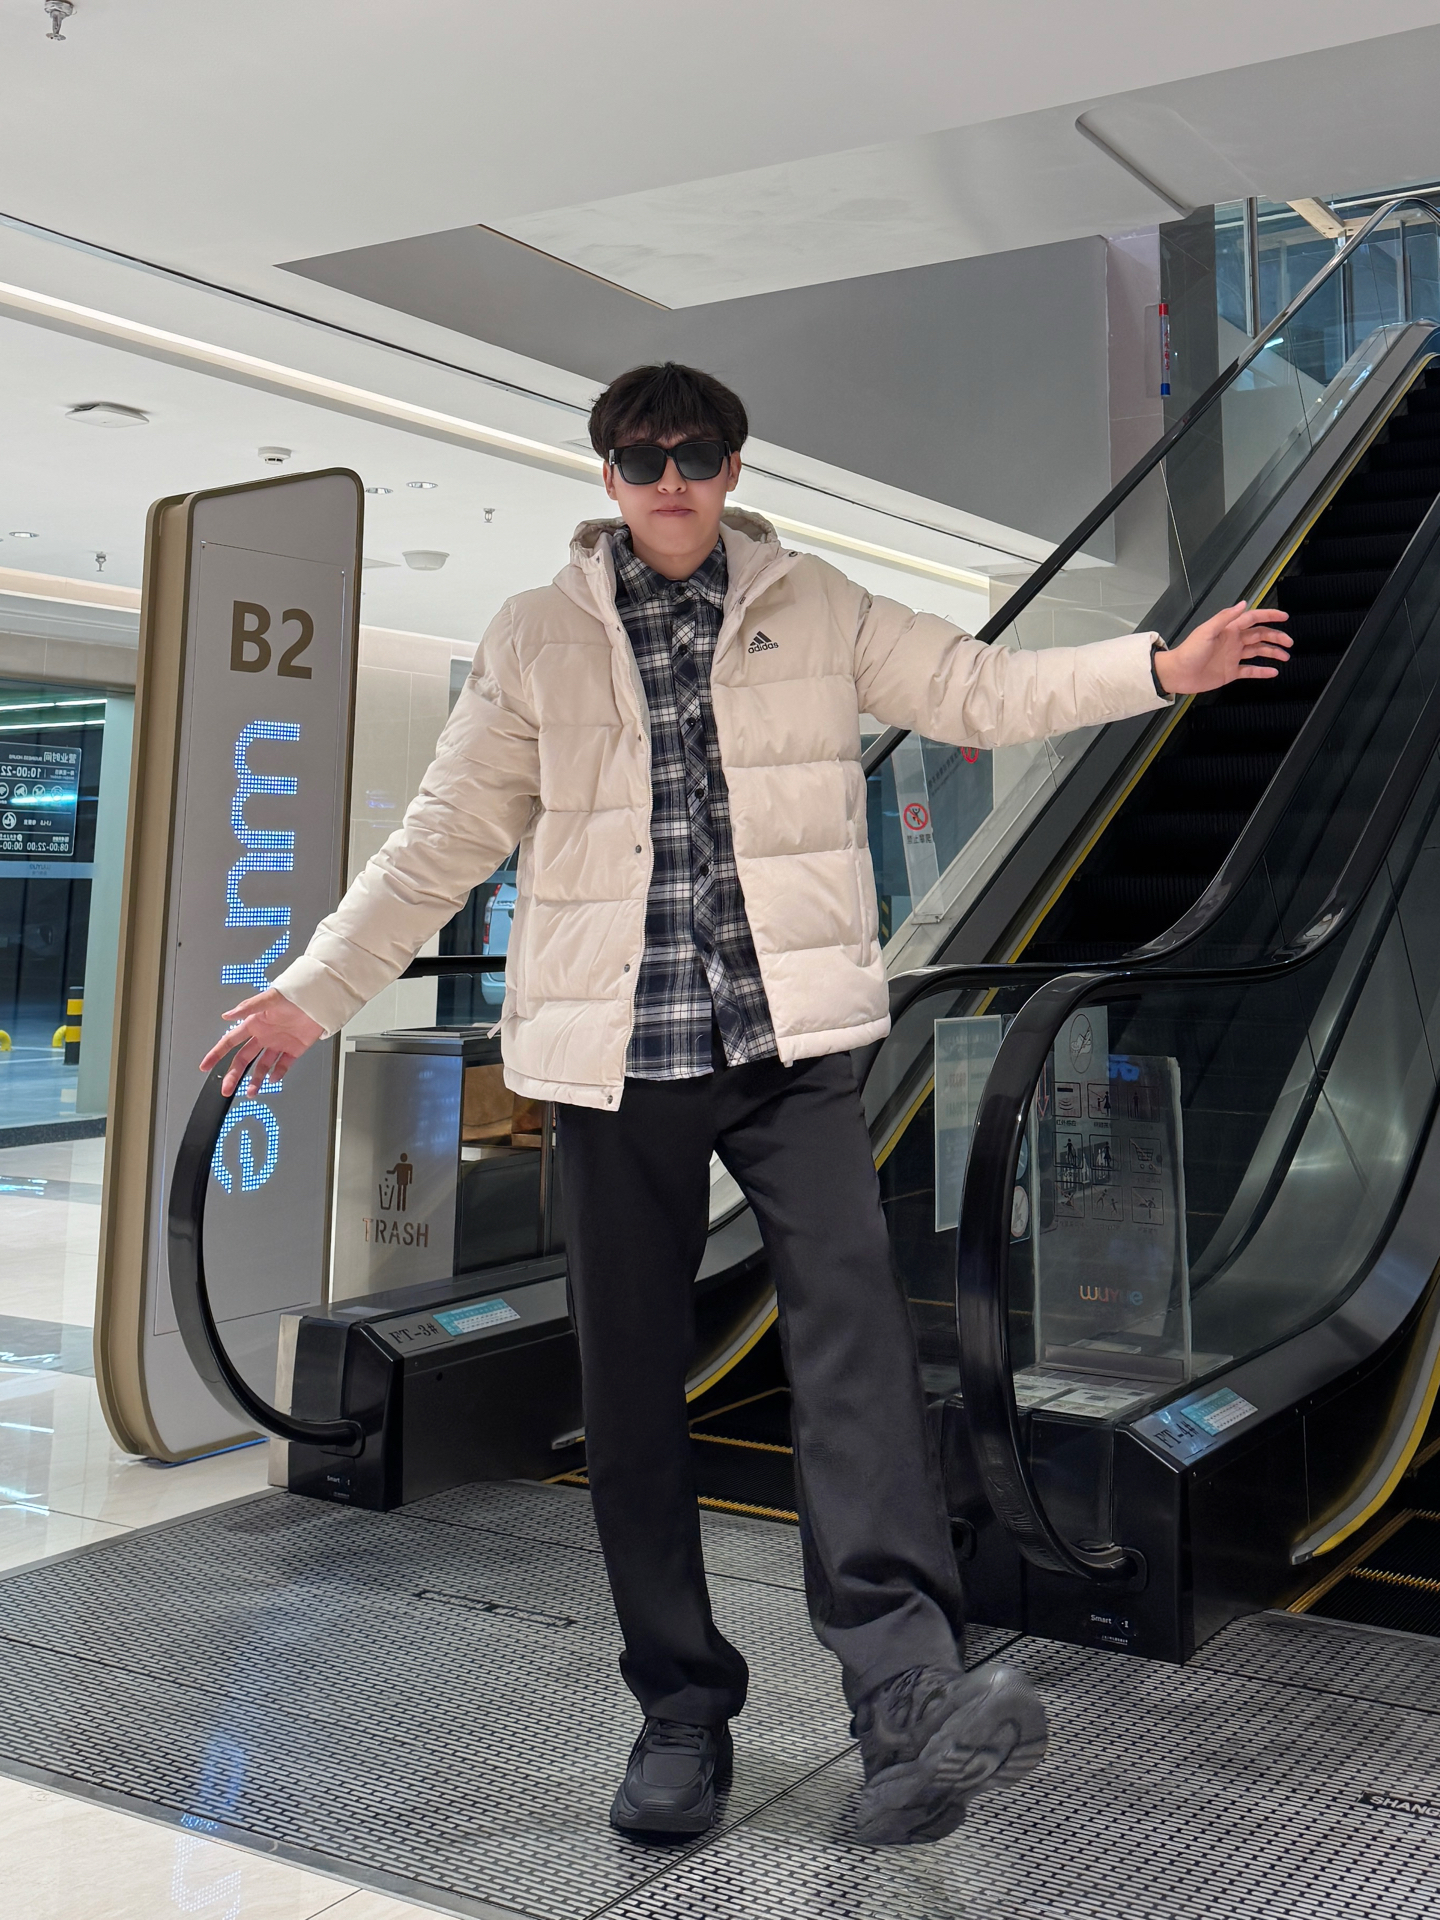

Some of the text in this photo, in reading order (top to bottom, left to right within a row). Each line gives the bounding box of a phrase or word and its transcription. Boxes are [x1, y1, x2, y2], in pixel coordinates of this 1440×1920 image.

[229, 599, 315, 680] B2
[748, 642, 779, 654] adidas
[210, 719, 301, 1194] wuye
[362, 1217, 430, 1248] TRASH
[388, 1322, 440, 1344] FT-3#
[1153, 1420, 1200, 1449] FT-4#
[420, 1592, 569, 1628] SHANGHAI MITSUBISHI
[1090, 1614, 1112, 1625] Smart
[1369, 1795, 1440, 1819] SHANG
